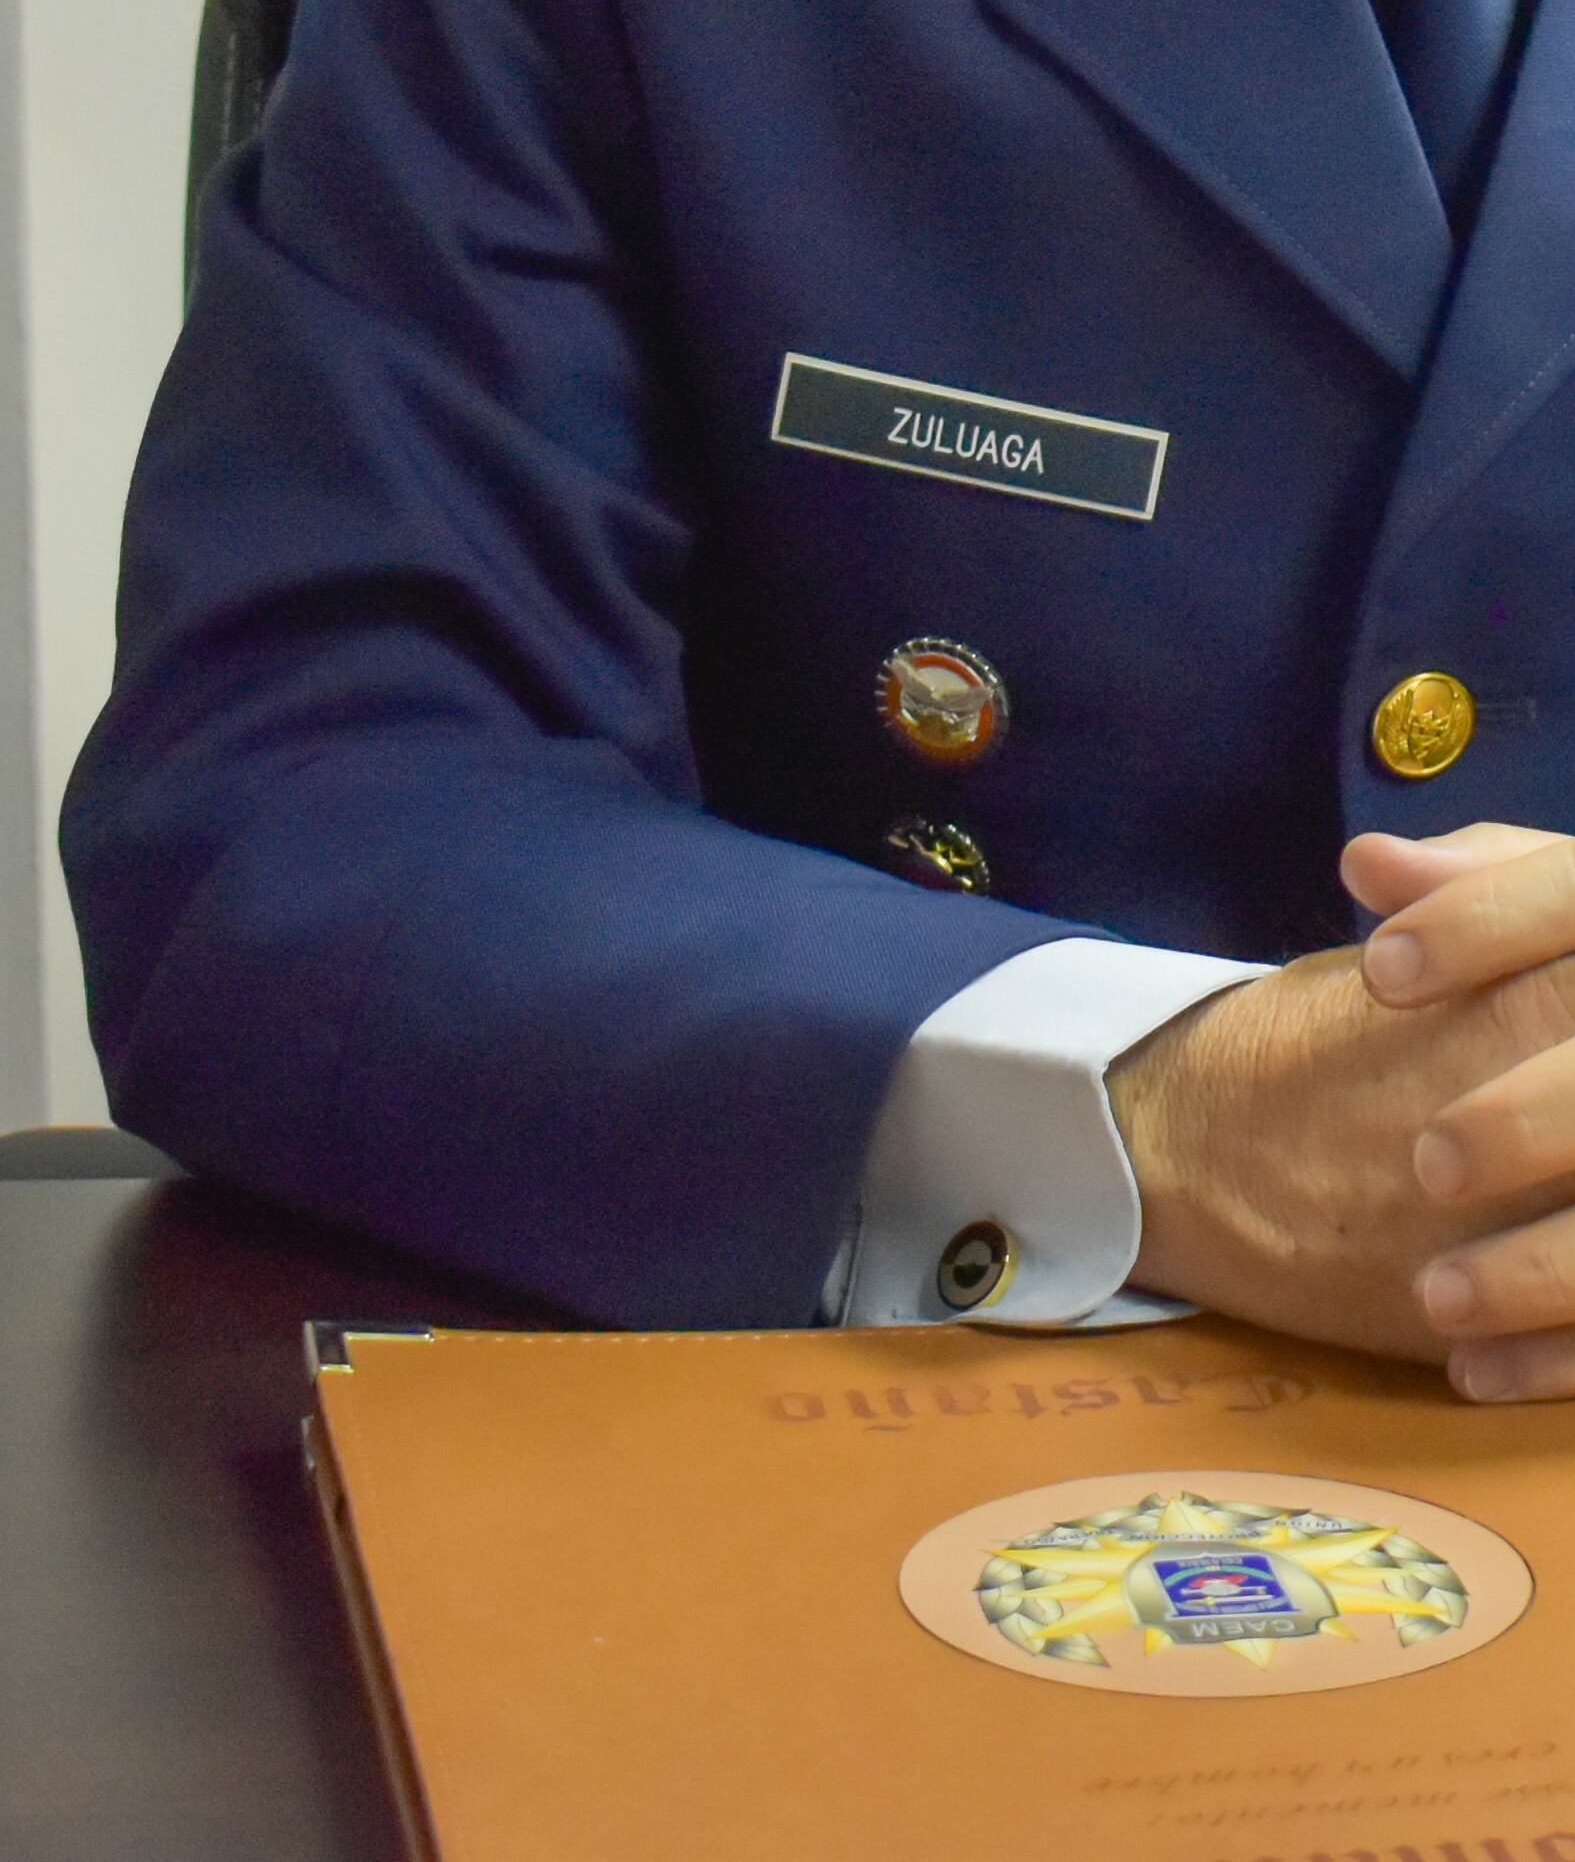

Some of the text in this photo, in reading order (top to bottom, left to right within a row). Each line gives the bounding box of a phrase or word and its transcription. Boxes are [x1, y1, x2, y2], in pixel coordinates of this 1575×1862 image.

[887, 407, 1045, 475] ZULUAGA
[765, 1370, 1315, 1433] Castaño
[1191, 1618, 1296, 1637] CAEM
